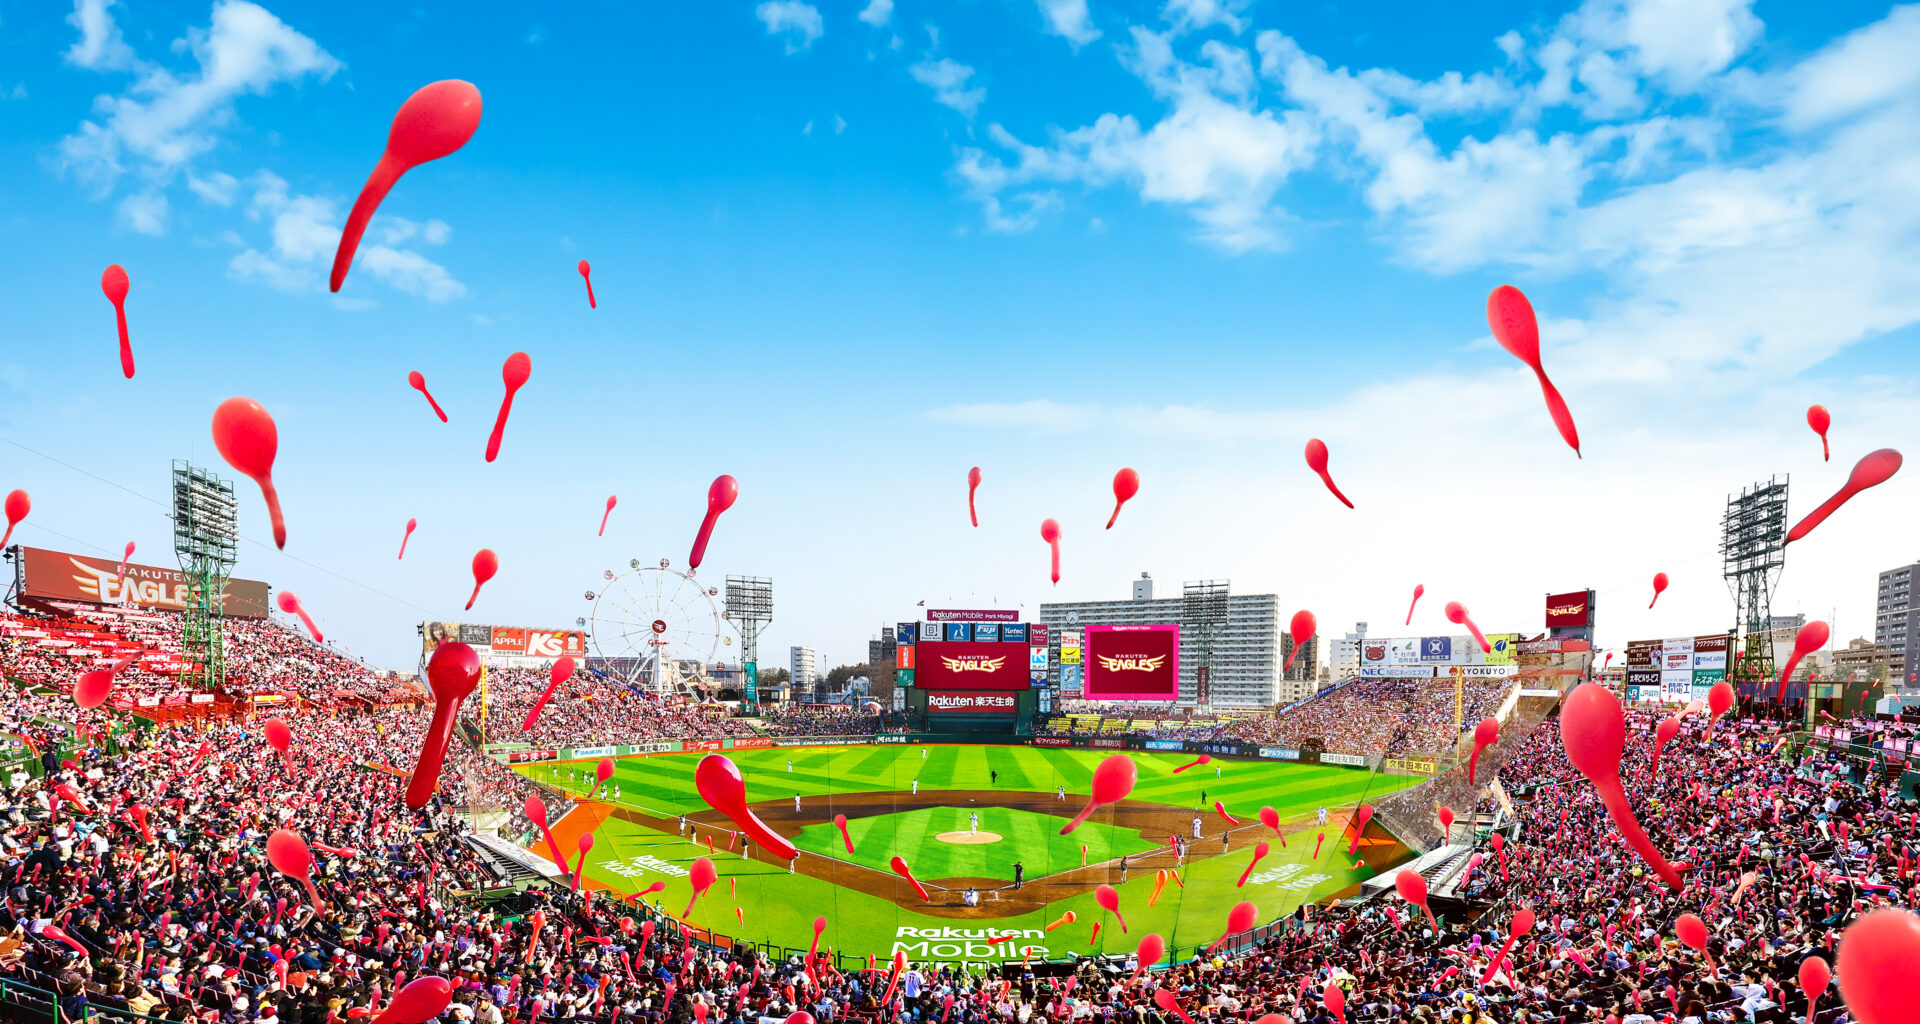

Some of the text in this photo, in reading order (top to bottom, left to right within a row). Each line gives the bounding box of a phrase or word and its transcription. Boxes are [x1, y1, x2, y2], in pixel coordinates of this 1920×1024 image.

[932, 611, 961, 620] Rakuten
[961, 611, 983, 619] Mobile
[493, 637, 524, 646] APPLE
[948, 658, 999, 672] EAGLES
[1106, 657, 1158, 672] EAGLES
[1362, 668, 1385, 676] NEC
[1694, 675, 1724, 685] トスネット
[1628, 689, 1638, 697] JR
[929, 695, 1014, 709] Rakuten 楽天生命
[639, 743, 666, 752] 東北電力
[1204, 745, 1237, 754] 小松物産
[519, 752, 550, 760] やまや
[1321, 754, 1364, 765] 三井住友銀行
[1389, 759, 1431, 772] 久保田本店
[896, 926, 1045, 940] Rakuten
[891, 941, 1050, 958] Mobile
